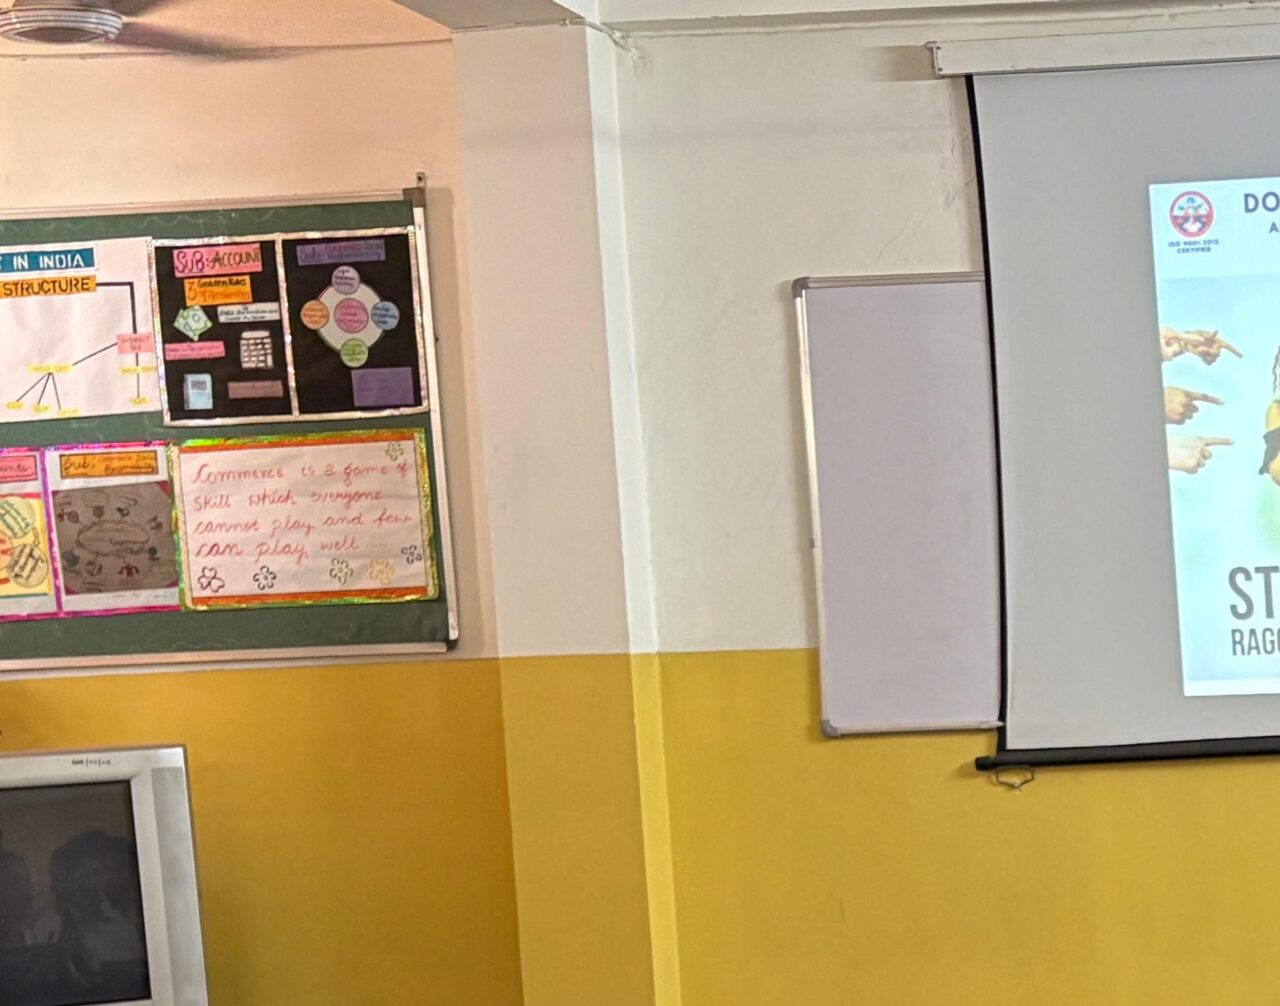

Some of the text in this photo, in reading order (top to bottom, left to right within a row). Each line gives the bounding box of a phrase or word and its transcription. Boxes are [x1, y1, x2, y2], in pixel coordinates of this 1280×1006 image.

[13, 253, 29, 271] IN
[39, 252, 85, 269] INDIA
[2, 276, 91, 297] STRUCTURE
[192, 463, 284, 485] Commerce
[300, 463, 315, 478] is
[324, 466, 338, 478] a
[343, 462, 389, 488] game
[249, 489, 297, 507] which
[310, 490, 385, 509] everyone
[192, 508, 413, 539] cannot play and few
[195, 536, 359, 565] can play well
